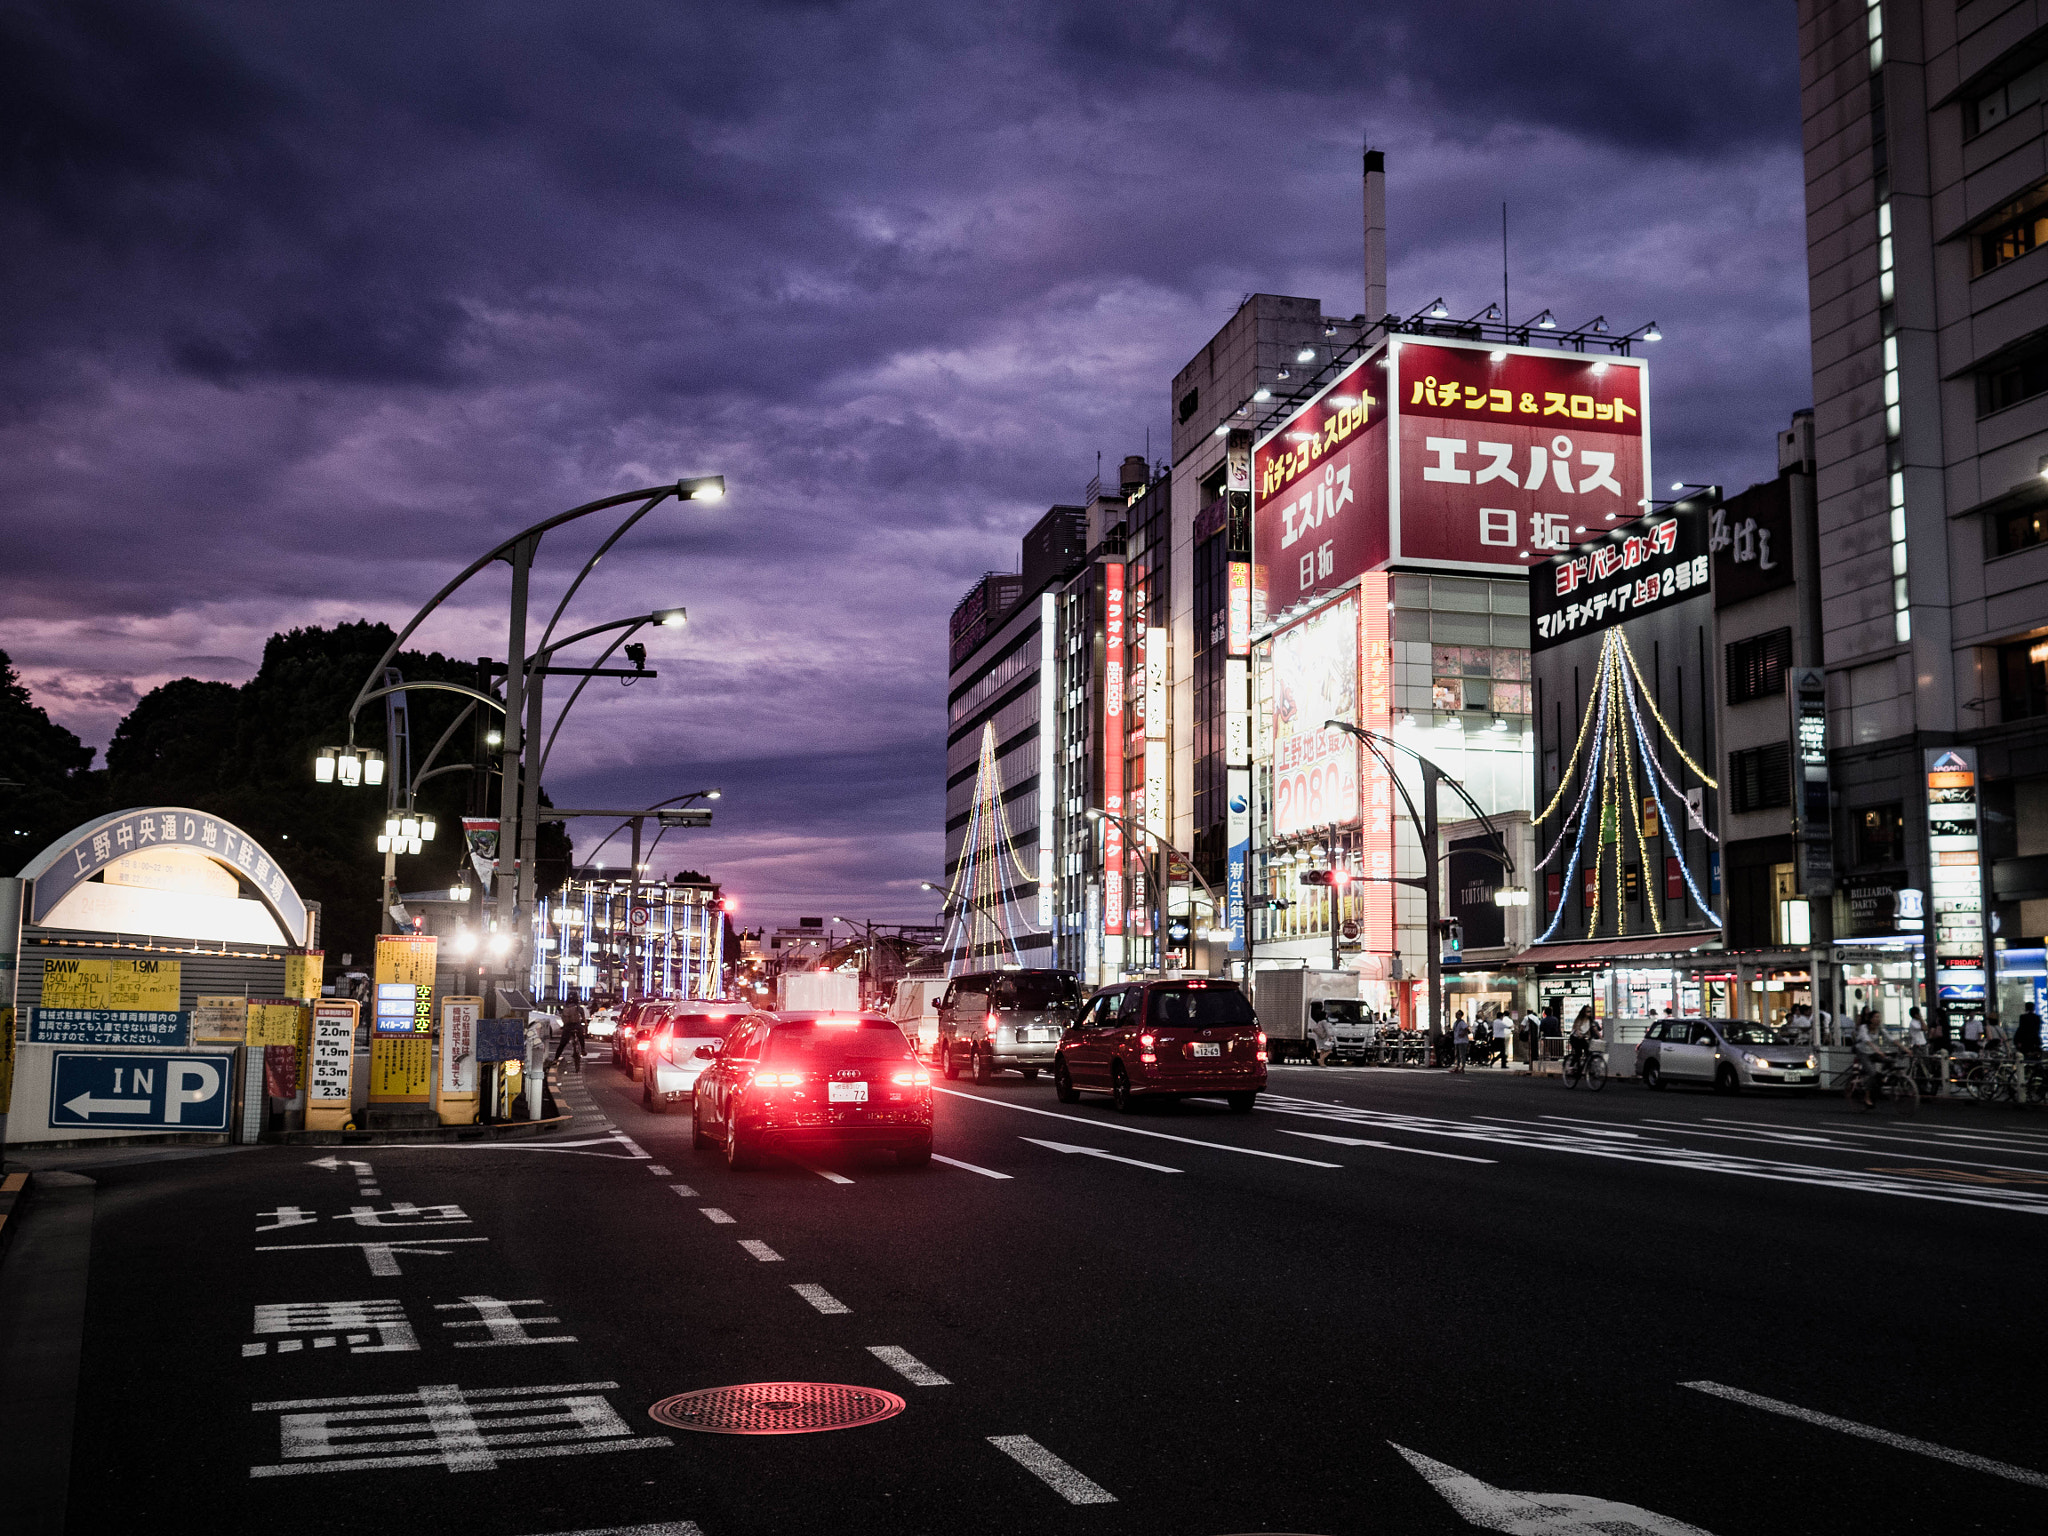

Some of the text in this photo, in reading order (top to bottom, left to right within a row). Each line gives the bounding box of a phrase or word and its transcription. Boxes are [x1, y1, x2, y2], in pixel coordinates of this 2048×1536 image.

[1423, 435, 1622, 497] エスパス
[1281, 463, 1354, 550] エスパス
[1479, 507, 1570, 551] 日拓
[1708, 508, 1778, 570] みはし
[1300, 539, 1334, 591] 日拓
[1555, 518, 1678, 597] ヨドバシカメラ
[1231, 562, 1247, 588] 麻雀
[1107, 588, 1123, 649] カラオケ
[1371, 641, 1388, 715] パチンコ
[1107, 796, 1122, 857] カラオケ
[73, 815, 286, 903] 上野中央通り地下駐車場
[1229, 862, 1245, 938] 新生銀行
[1461, 885, 1493, 905] TSUTSUMI
[1851, 886, 1893, 899] BILLIARDS
[1851, 899, 1878, 910] DARTS
[45, 960, 80, 973] BMW
[416, 984, 432, 1000] 空
[39, 1010, 177, 1023] 機械式駐車場につき車両制限内の
[415, 1001, 431, 1016] 空
[38, 1020, 177, 1033] 車両であっても入庫できない場合が
[320, 1028, 350, 1037] 2.0m
[414, 1016, 431, 1033] 空
[461, 1007, 471, 1055] この駐車場は
[38, 1031, 162, 1044] ありますので、ご了承ください。
[319, 1048, 349, 1057] 1.9m
[1200, 1047, 1219, 1056] 12-69
[318, 1067, 348, 1077] 5.3m
[114, 1067, 154, 1095] IN
[164, 1061, 220, 1124] P
[323, 1087, 347, 1097] 2.3t
